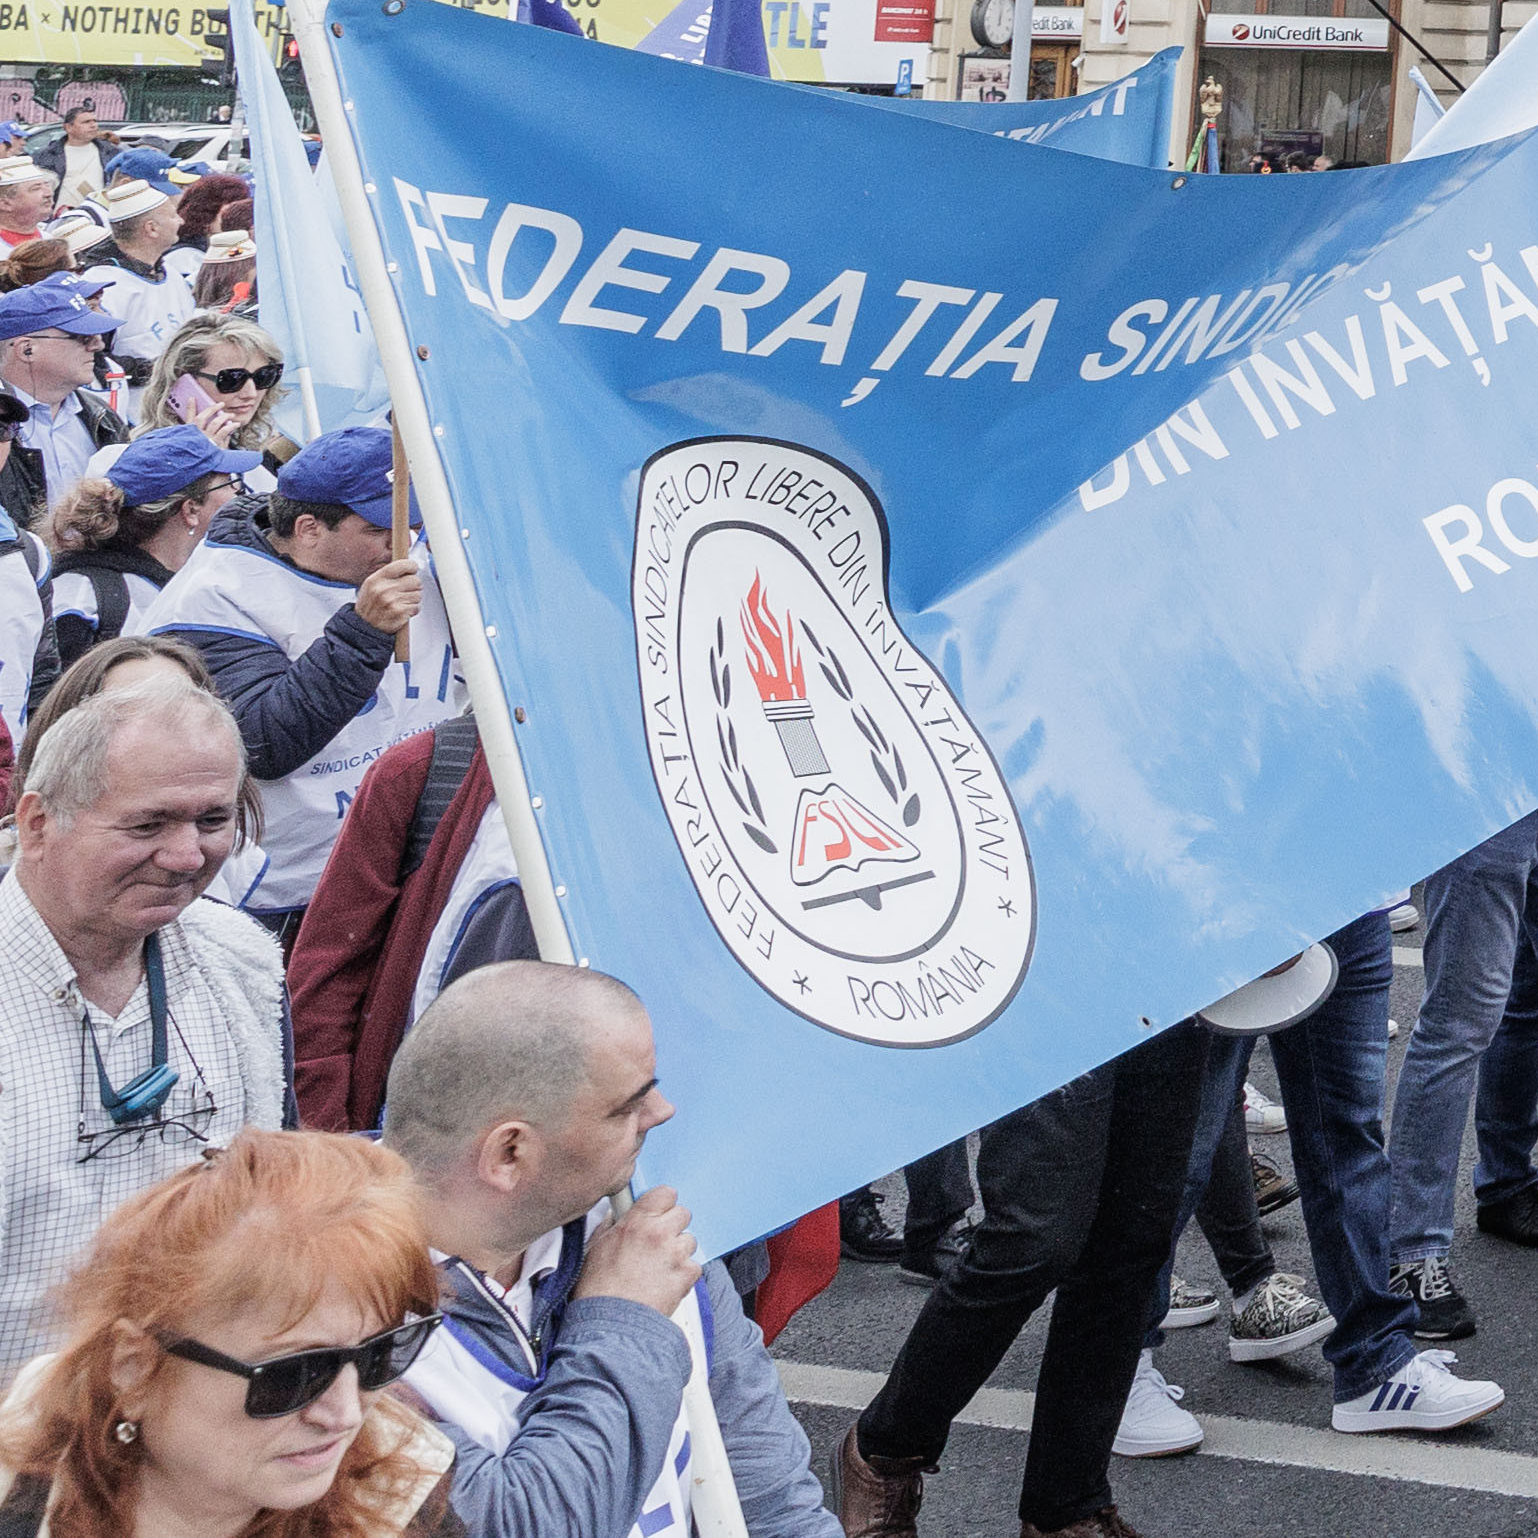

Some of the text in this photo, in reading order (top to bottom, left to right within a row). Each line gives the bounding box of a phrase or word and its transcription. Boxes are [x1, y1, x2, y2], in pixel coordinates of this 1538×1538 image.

[61, 5, 179, 36] NOTHING
[1051, 17, 1075, 30] Bank
[1252, 24, 1364, 43] UniCredit Bank
[392, 176, 1059, 407] FEDERAȚIA
[643, 458, 740, 676] SINDICATELOR
[745, 460, 840, 541] LIBERE
[826, 520, 871, 610] DIN
[310, 746, 383, 776] SINDICAT
[846, 944, 997, 1024] ROMÂNIA
